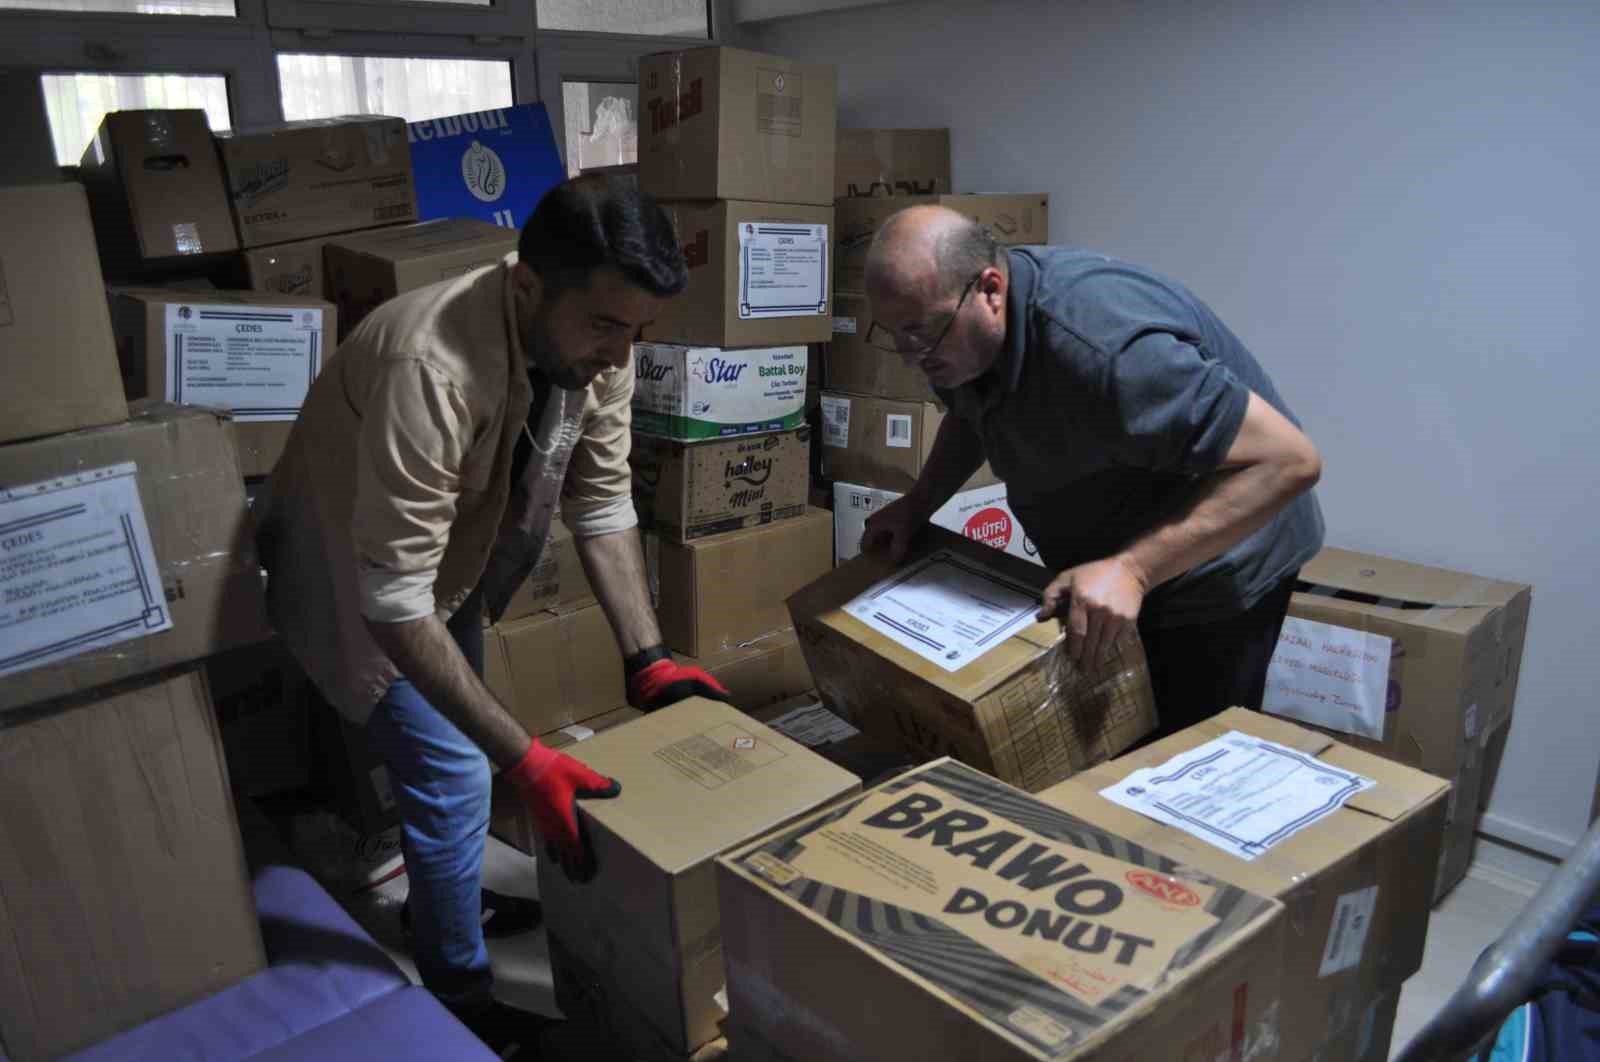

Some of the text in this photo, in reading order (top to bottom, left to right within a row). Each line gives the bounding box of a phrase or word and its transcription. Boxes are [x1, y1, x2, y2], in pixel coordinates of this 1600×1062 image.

[705, 357, 748, 384] Star
[788, 363, 806, 377] Boy
[861, 791, 1124, 917] BRAWO
[942, 887, 1156, 967] DONUT
